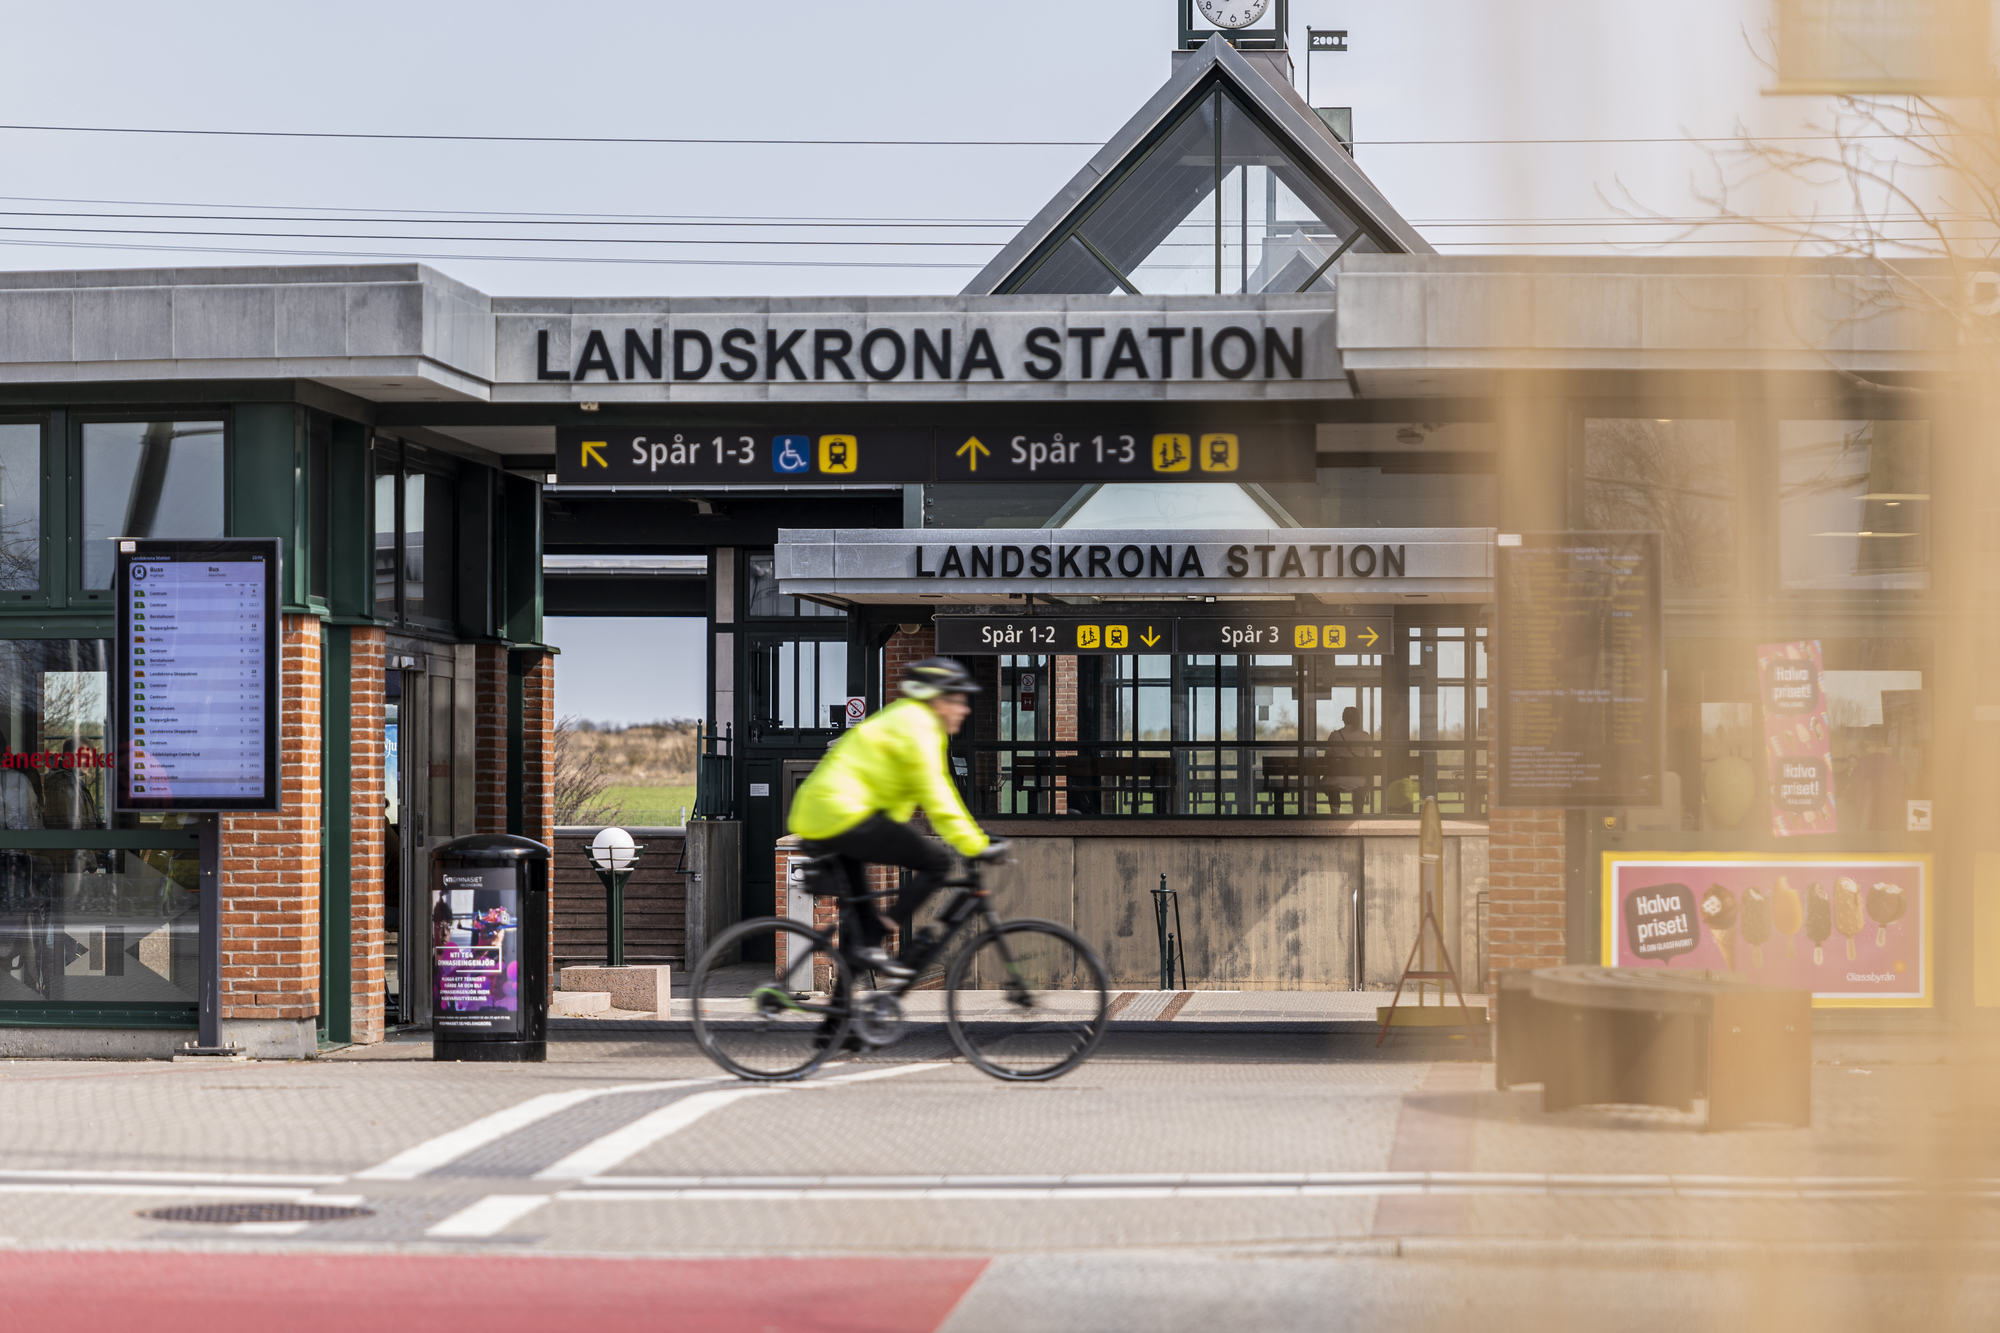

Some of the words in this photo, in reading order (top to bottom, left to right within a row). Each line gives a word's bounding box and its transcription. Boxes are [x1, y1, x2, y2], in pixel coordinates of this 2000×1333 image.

[1206, 1, 1212, 10] 8
[1216, 11, 1223, 20] 7
[1230, 14, 1237, 22] 6
[1244, 10, 1251, 19] 5
[1313, 36, 1339, 45] 2000
[536, 327, 1004, 381] LANDSKRONA
[1023, 326, 1302, 380] STATION
[632, 434, 700, 472] Spår
[712, 436, 756, 465] 1-3
[1010, 432, 1081, 471] Spår
[1091, 435, 1136, 464] 1-3
[916, 545, 1204, 578] LANDSKRONA
[1226, 544, 1405, 578] STATION
[982, 624, 1023, 648] Spår
[1030, 626, 1056, 644] 1-2
[1221, 625, 1263, 648] Spår
[1268, 626, 1279, 643] 3
[1774, 666, 1808, 680] Halva
[1773, 683, 1812, 701] priset!
[0, 746, 115, 768] ånetrafike
[1783, 763, 1816, 778] Halva
[1781, 781, 1819, 798] priset!
[1636, 894, 1681, 915] Halva
[1637, 914, 1688, 943] priset!
[1639, 944, 1647, 953] PÅ
[1647, 944, 1657, 952] DIN
[1657, 938, 1693, 950] GLASSFAVORIT
[1846, 972, 1895, 984] Glassbyrån
